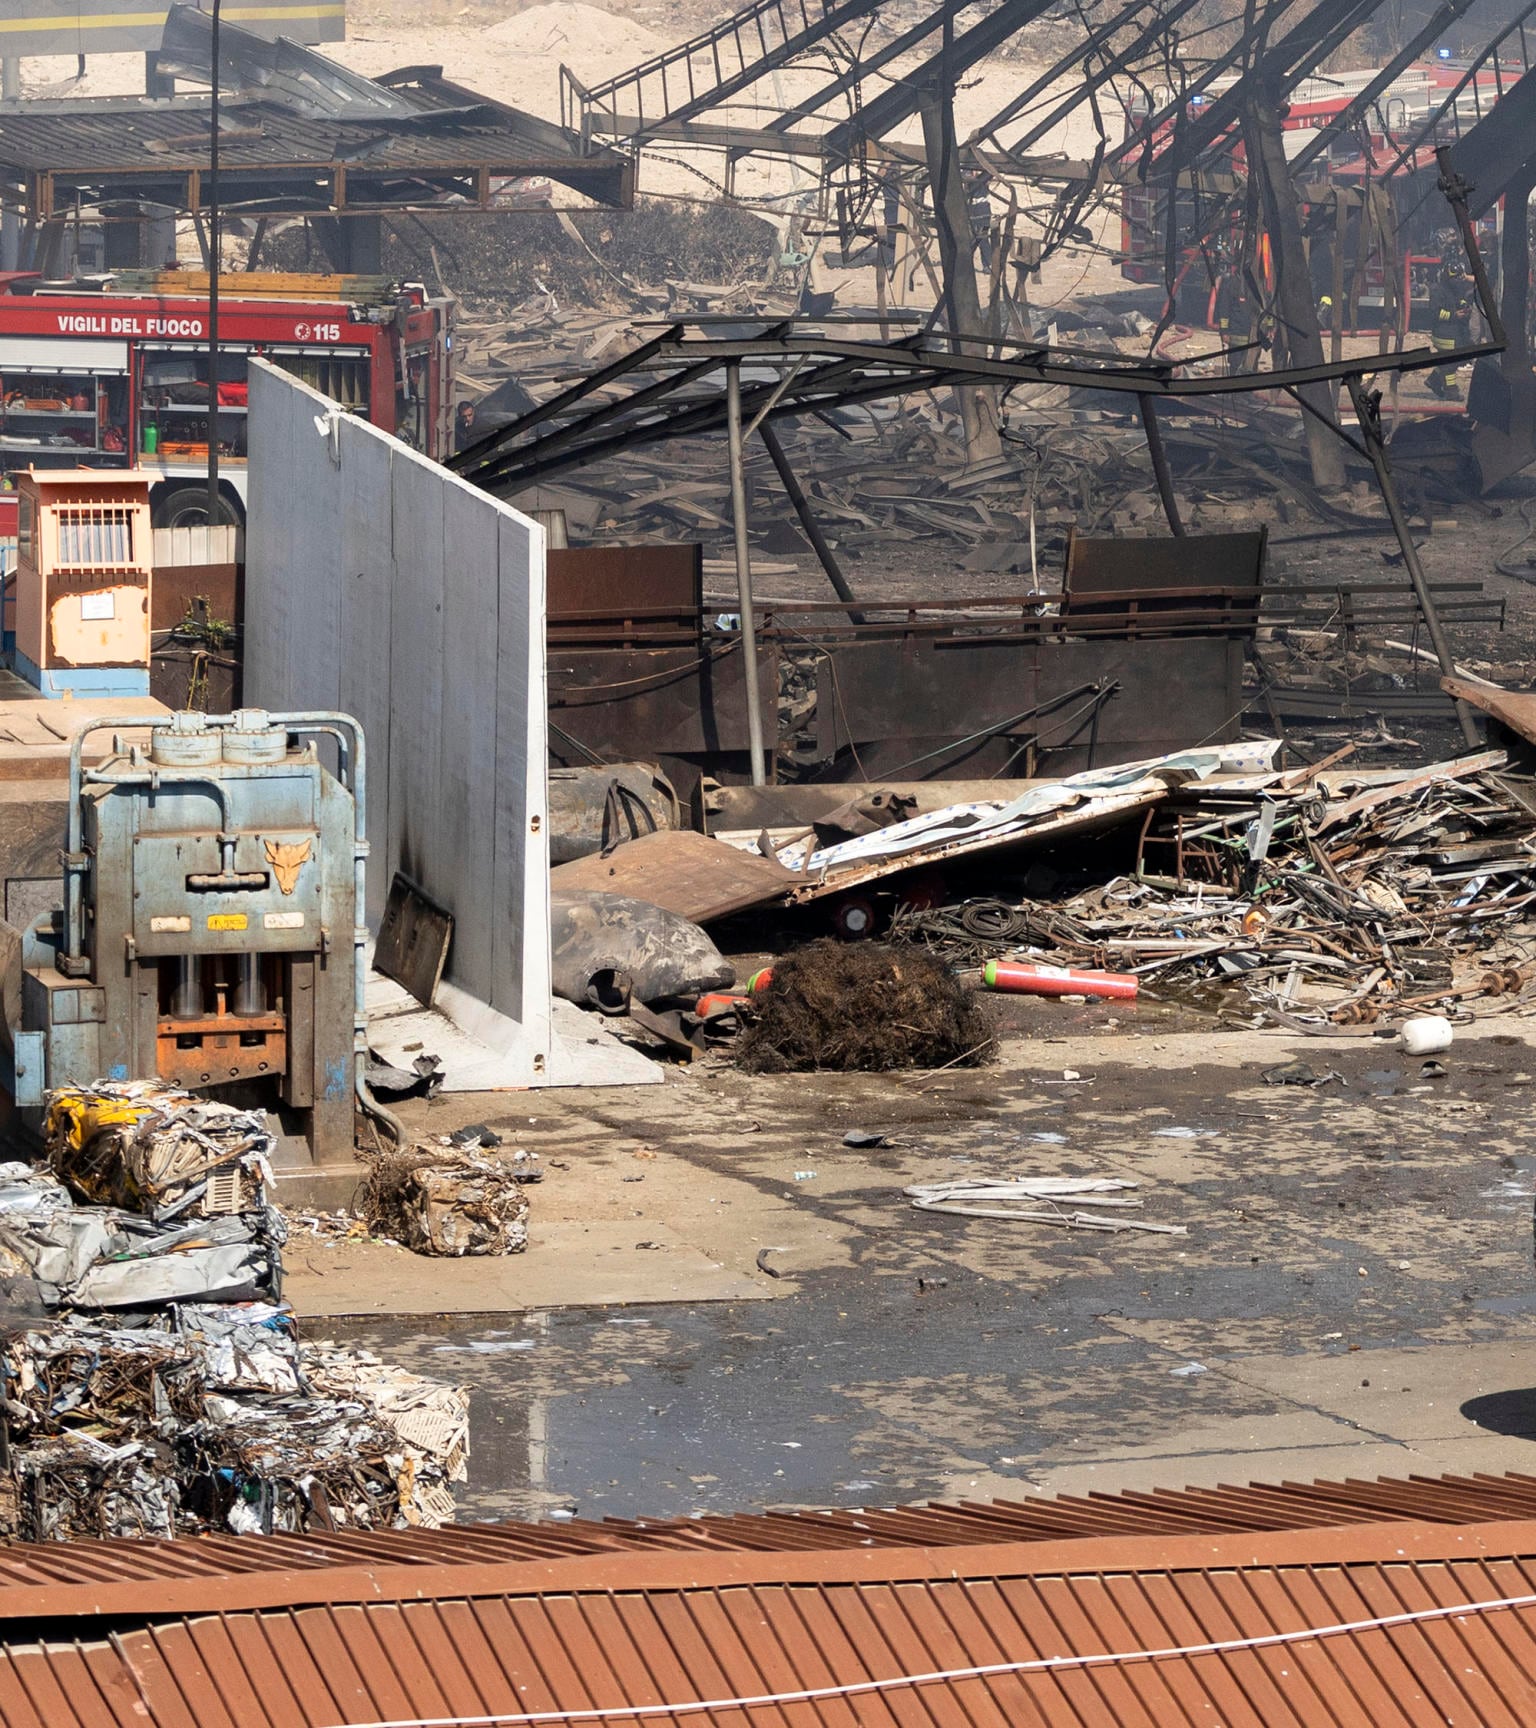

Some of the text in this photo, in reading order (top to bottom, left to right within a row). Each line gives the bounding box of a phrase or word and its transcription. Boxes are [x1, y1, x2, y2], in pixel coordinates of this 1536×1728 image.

[57, 315, 202, 336] VIGILI DEL FUOCO
[313, 323, 340, 340] 115
